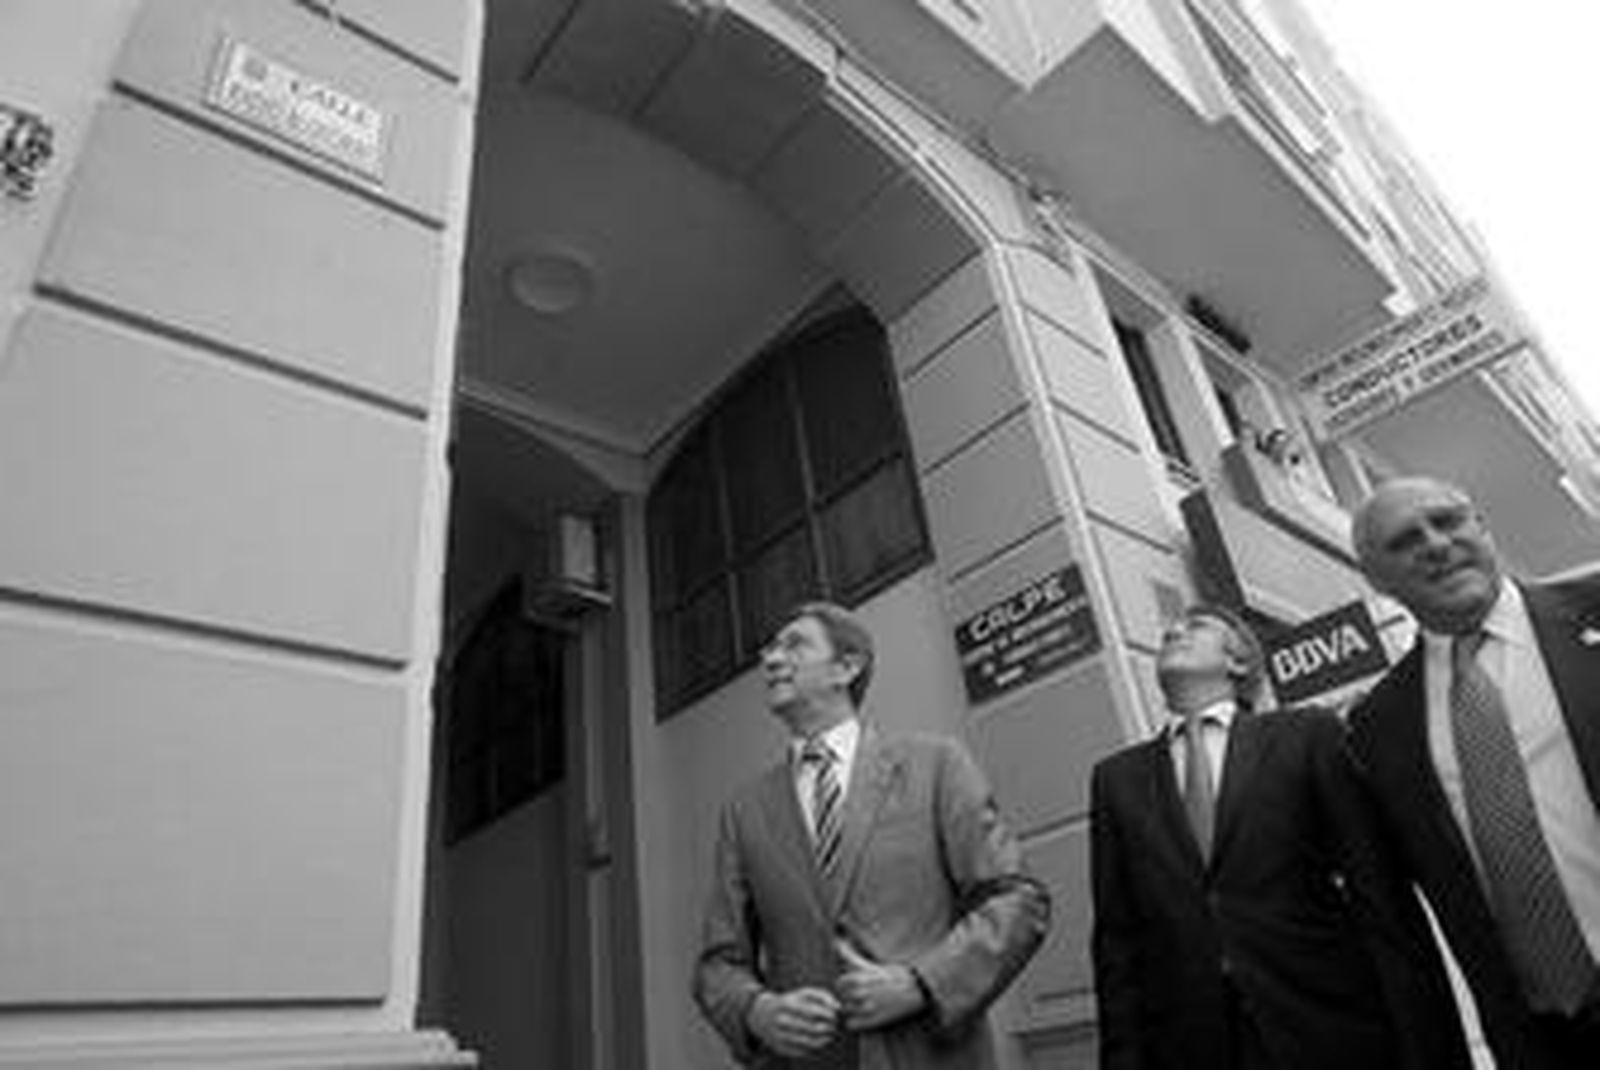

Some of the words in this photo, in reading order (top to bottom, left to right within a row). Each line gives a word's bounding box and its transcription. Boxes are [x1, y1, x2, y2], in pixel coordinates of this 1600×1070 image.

[1323, 312, 1483, 408] CONDUCTORES
[969, 575, 1067, 641] CALPE
[1271, 623, 1370, 683] BBVA
